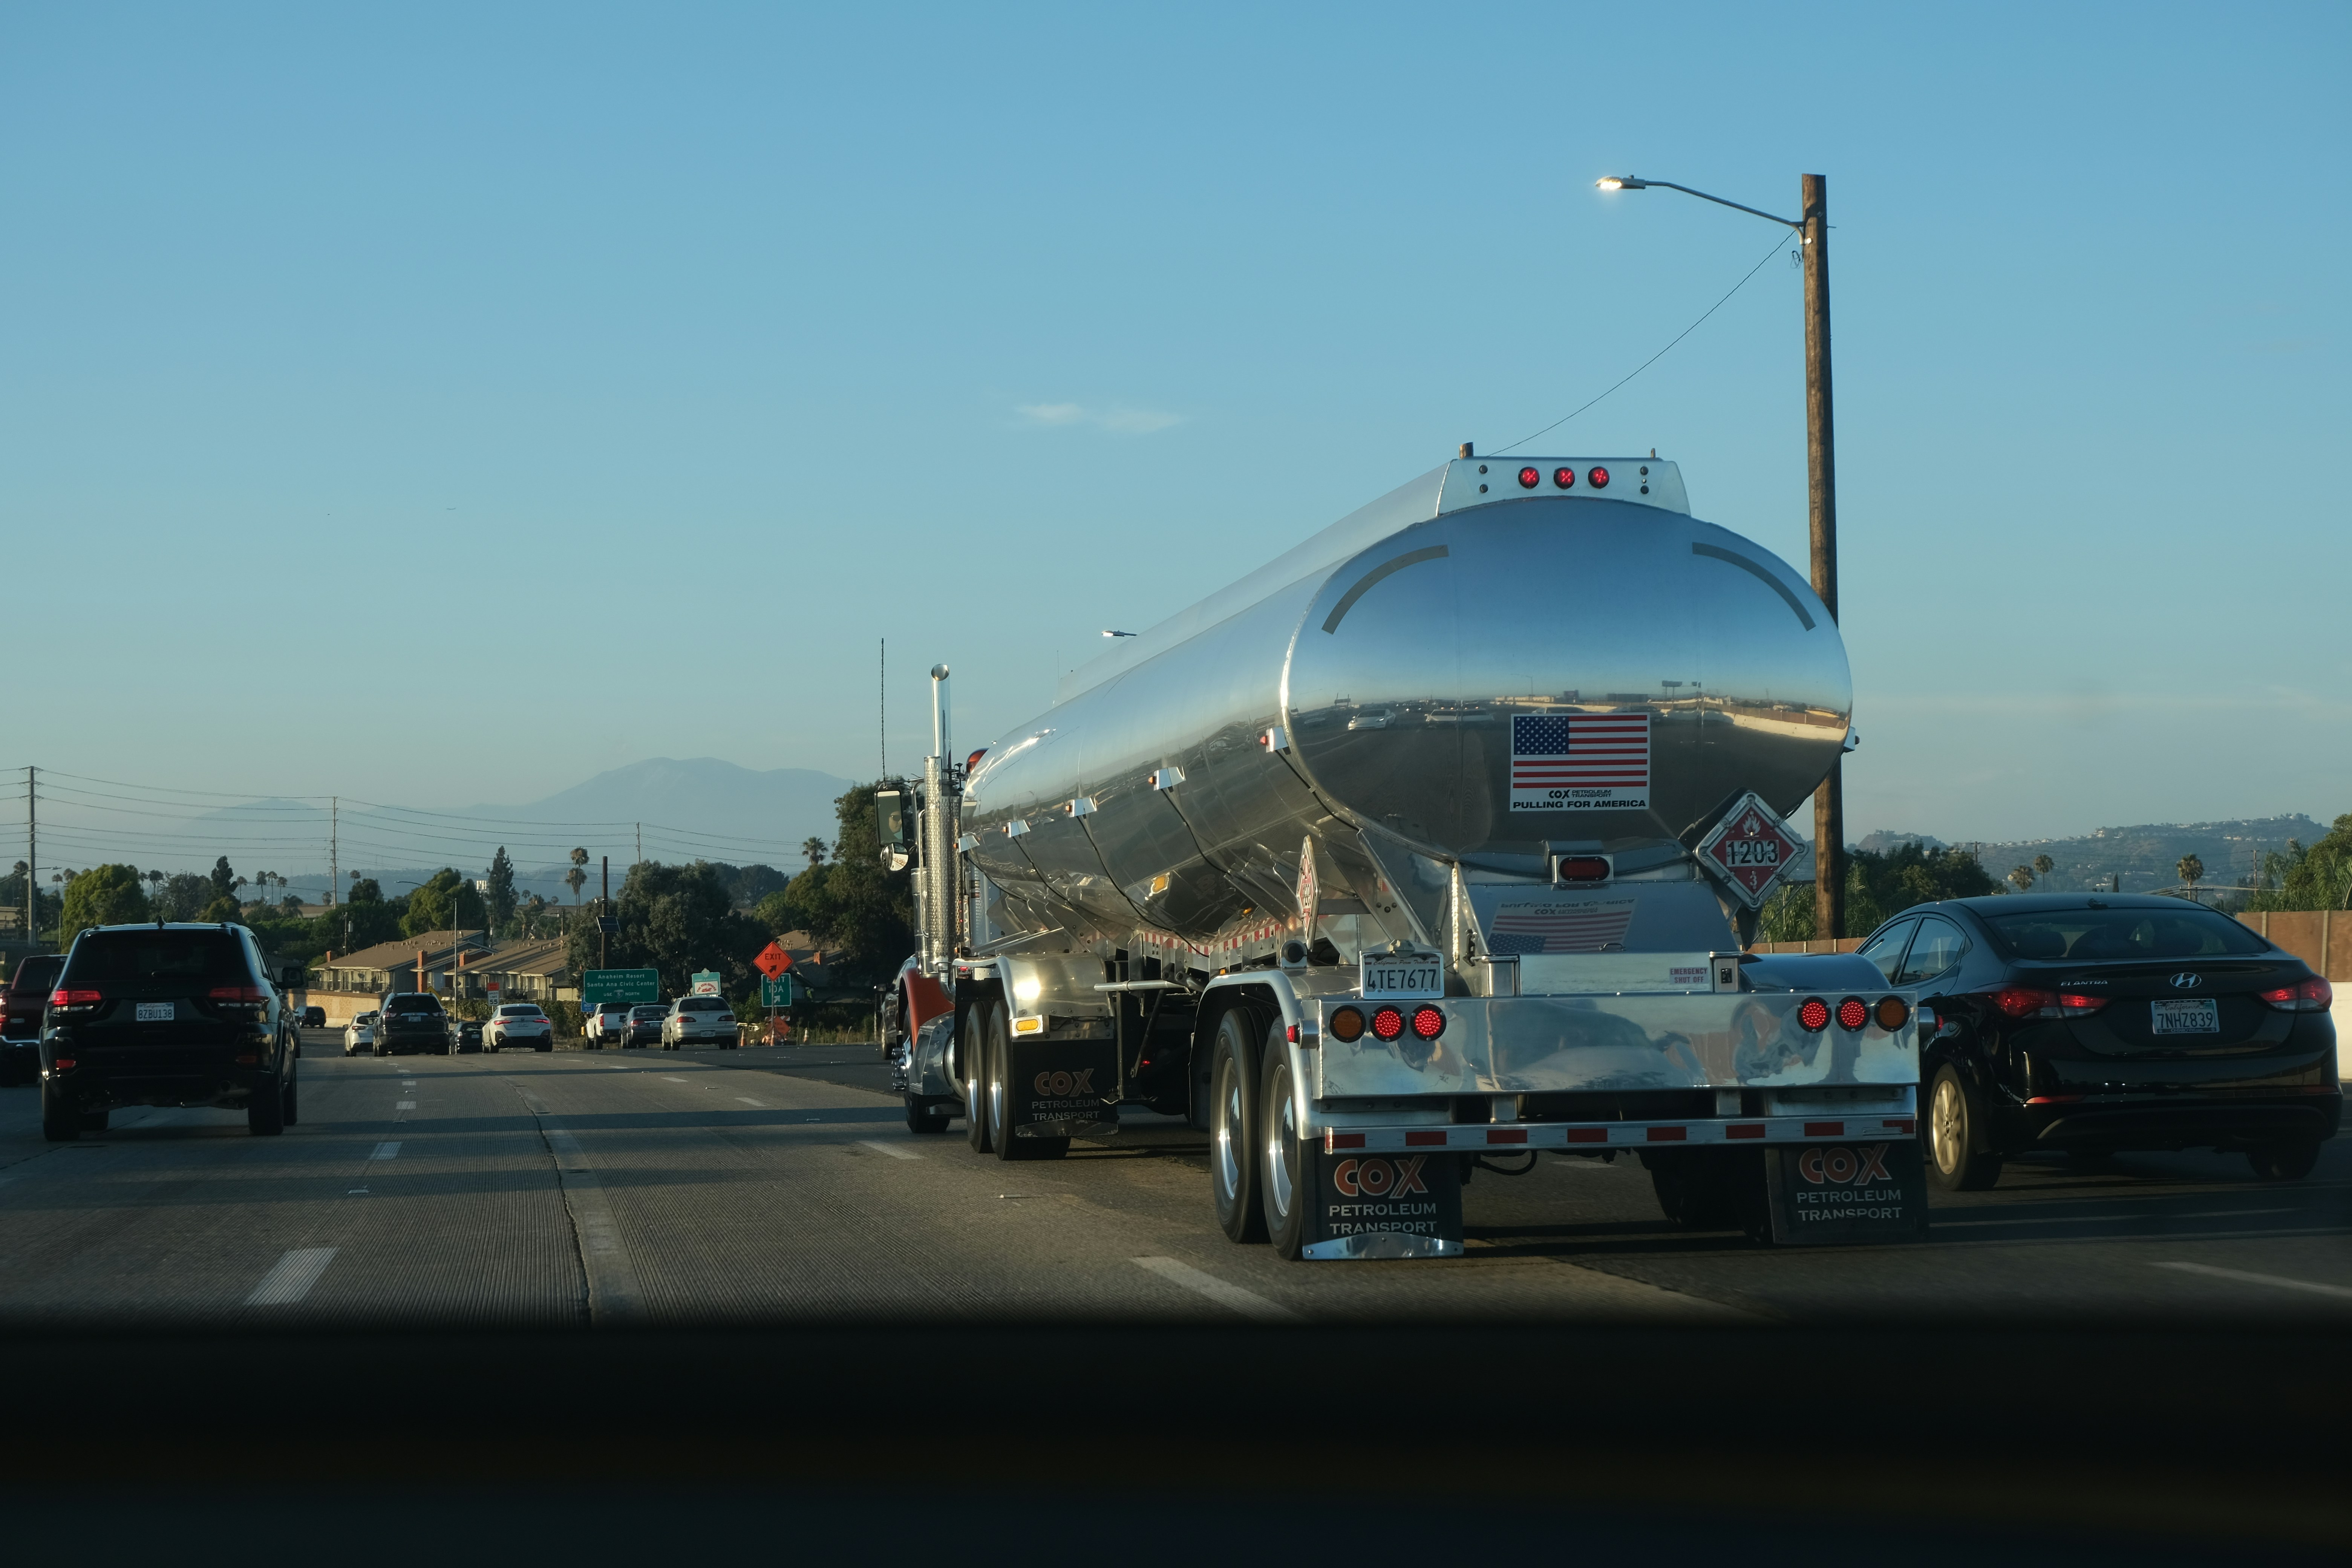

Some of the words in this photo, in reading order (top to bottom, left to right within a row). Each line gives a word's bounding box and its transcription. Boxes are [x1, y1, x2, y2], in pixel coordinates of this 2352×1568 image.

[1549, 789, 1570, 799] COX
[1727, 840, 1778, 864] 1203
[1750, 875, 1757, 886] 3
[1367, 969, 1436, 989] 4TE7677
[138, 1009, 172, 1018] 8ZBU138
[2165, 1003, 2200, 1012] California
[2157, 1012, 2213, 1028] 7NHZ839
[1034, 1068, 1094, 1097] COX
[1032, 1099, 1099, 1109] PETROLEUM
[1032, 1111, 1100, 1121] TRANSPORT
[1799, 1143, 1892, 1185] COX
[1334, 1155, 1429, 1199] COX
[1797, 1190, 1901, 1203] PETROLEUM
[1329, 1203, 1436, 1216] PETROLEUM
[1798, 1207, 1902, 1221] TRANSPORT
[1330, 1221, 1437, 1234] TRANSPORT
